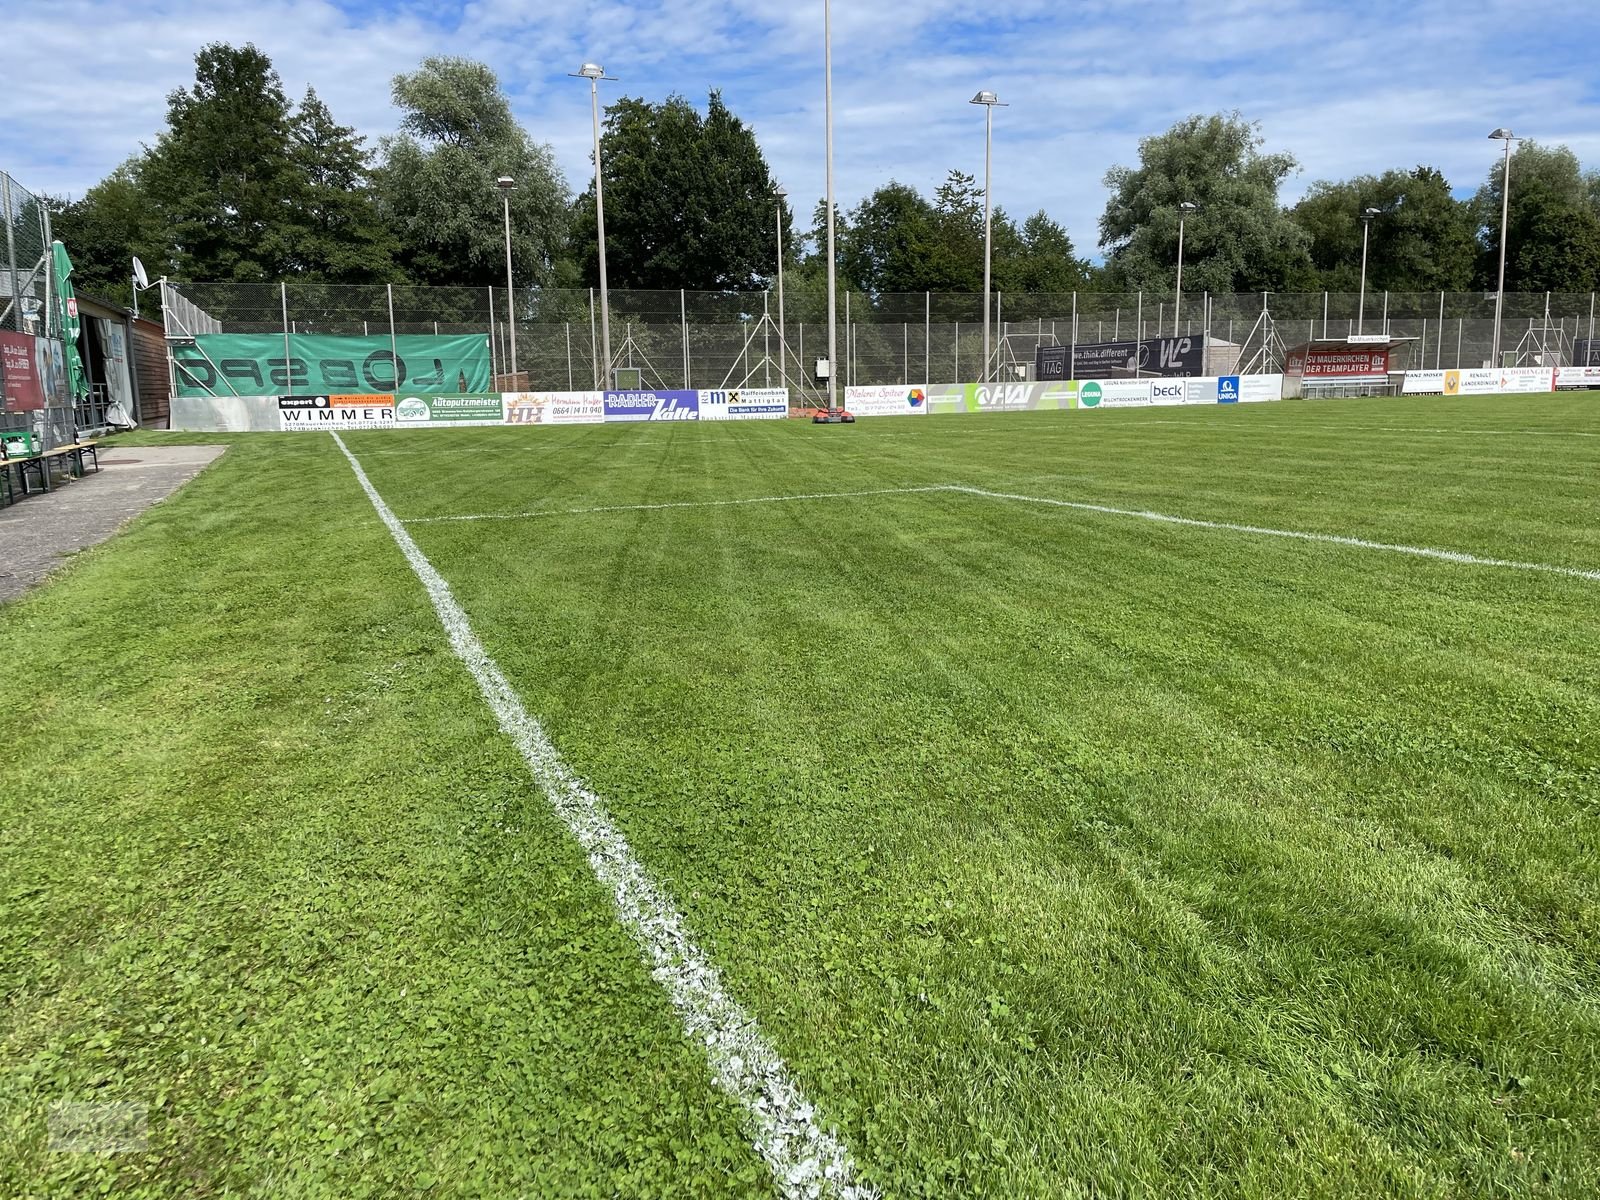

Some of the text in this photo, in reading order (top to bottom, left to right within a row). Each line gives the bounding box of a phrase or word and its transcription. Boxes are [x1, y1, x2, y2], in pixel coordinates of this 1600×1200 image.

[1318, 354, 1370, 363] MAUERKIRCHEN
[1306, 365, 1321, 373] DER
[1323, 364, 1370, 373] TEAMPLAYER
[1153, 385, 1182, 397] beck
[431, 398, 500, 408] Autoputzmeister
[282, 409, 393, 421] WIMMER
